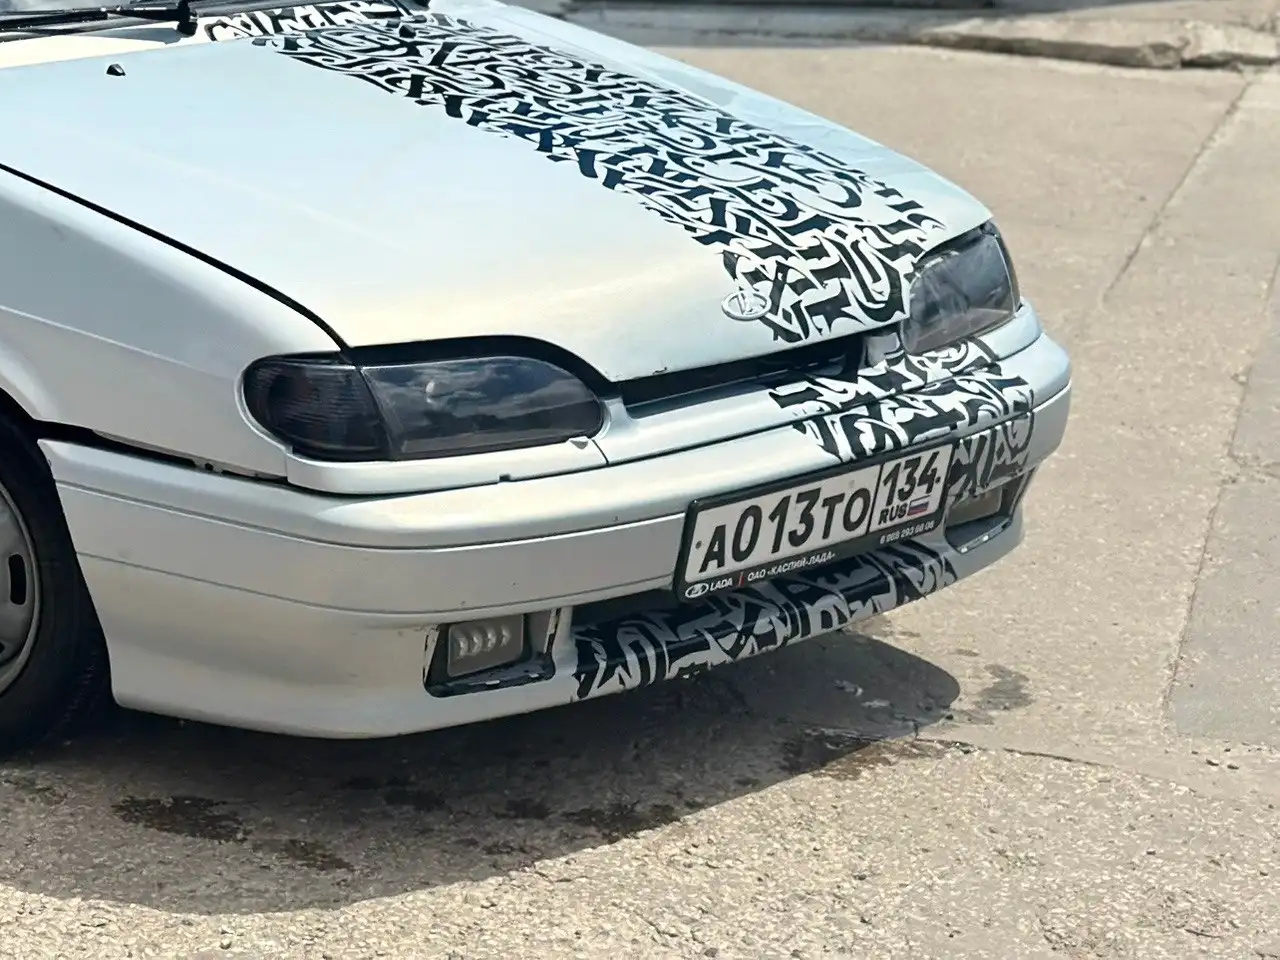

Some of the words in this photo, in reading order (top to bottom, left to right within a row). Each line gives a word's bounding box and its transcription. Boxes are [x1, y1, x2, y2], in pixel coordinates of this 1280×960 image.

[883, 451, 939, 506] 134
[878, 503, 908, 525] RUS
[699, 488, 871, 573] А013ТО
[709, 578, 732, 591] LADA
[747, 569, 766, 581] ОАО
